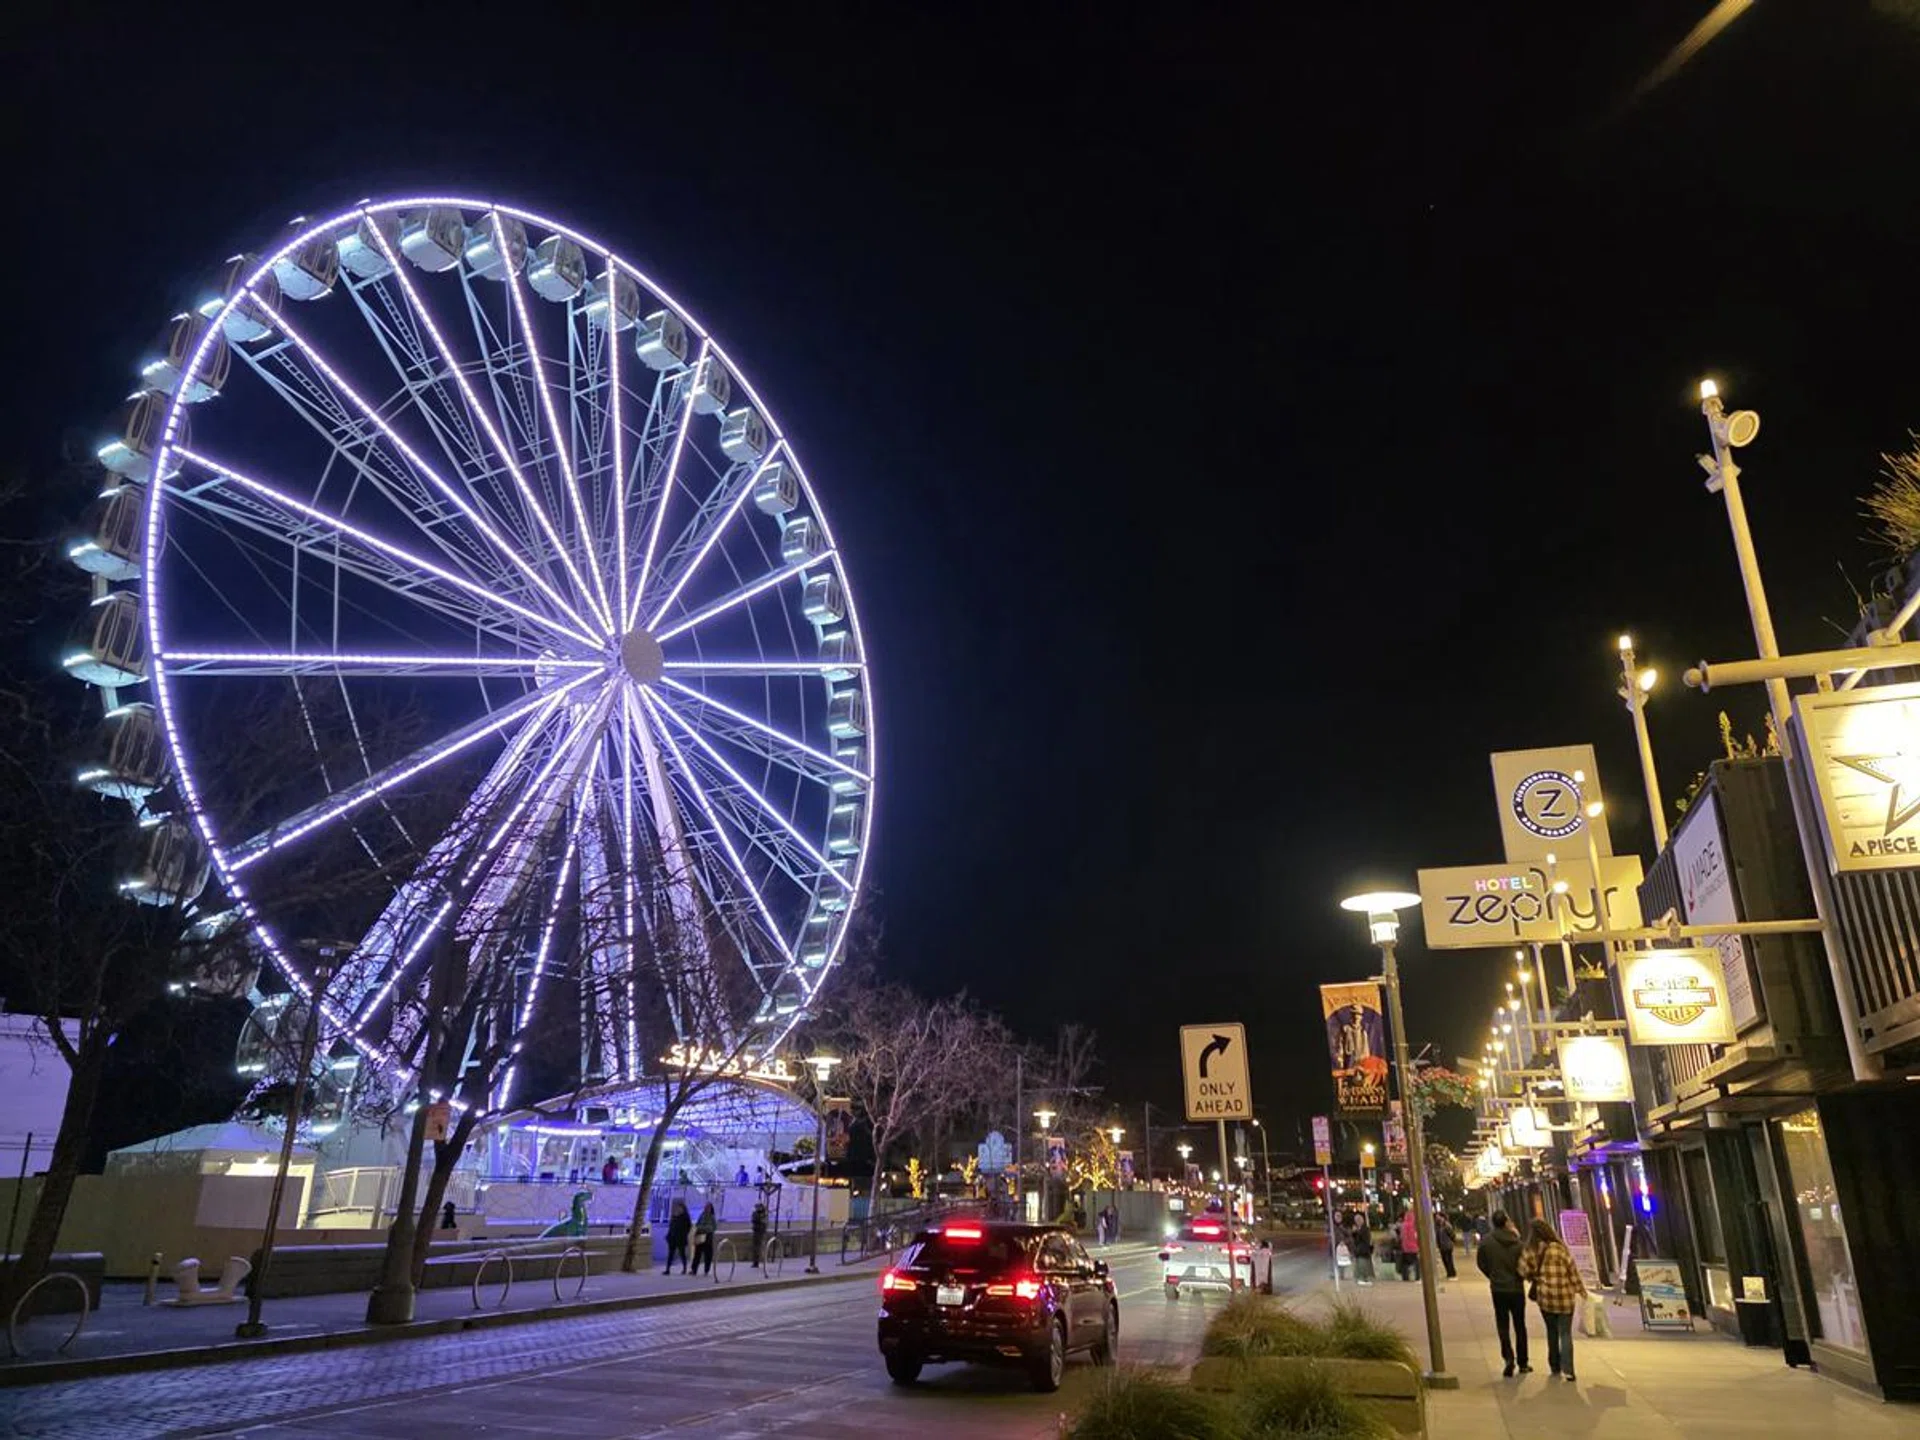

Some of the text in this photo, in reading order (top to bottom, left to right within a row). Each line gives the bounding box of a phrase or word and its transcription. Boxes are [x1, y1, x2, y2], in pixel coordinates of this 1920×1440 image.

[1536, 789, 1566, 817] Z
[1850, 836, 1918, 857] A PIECE
[1474, 877, 1533, 892] HOTEL
[1446, 867, 1618, 936] zephyr
[1199, 1082, 1235, 1096] ONLY
[1195, 1099, 1243, 1114] AHEAD
